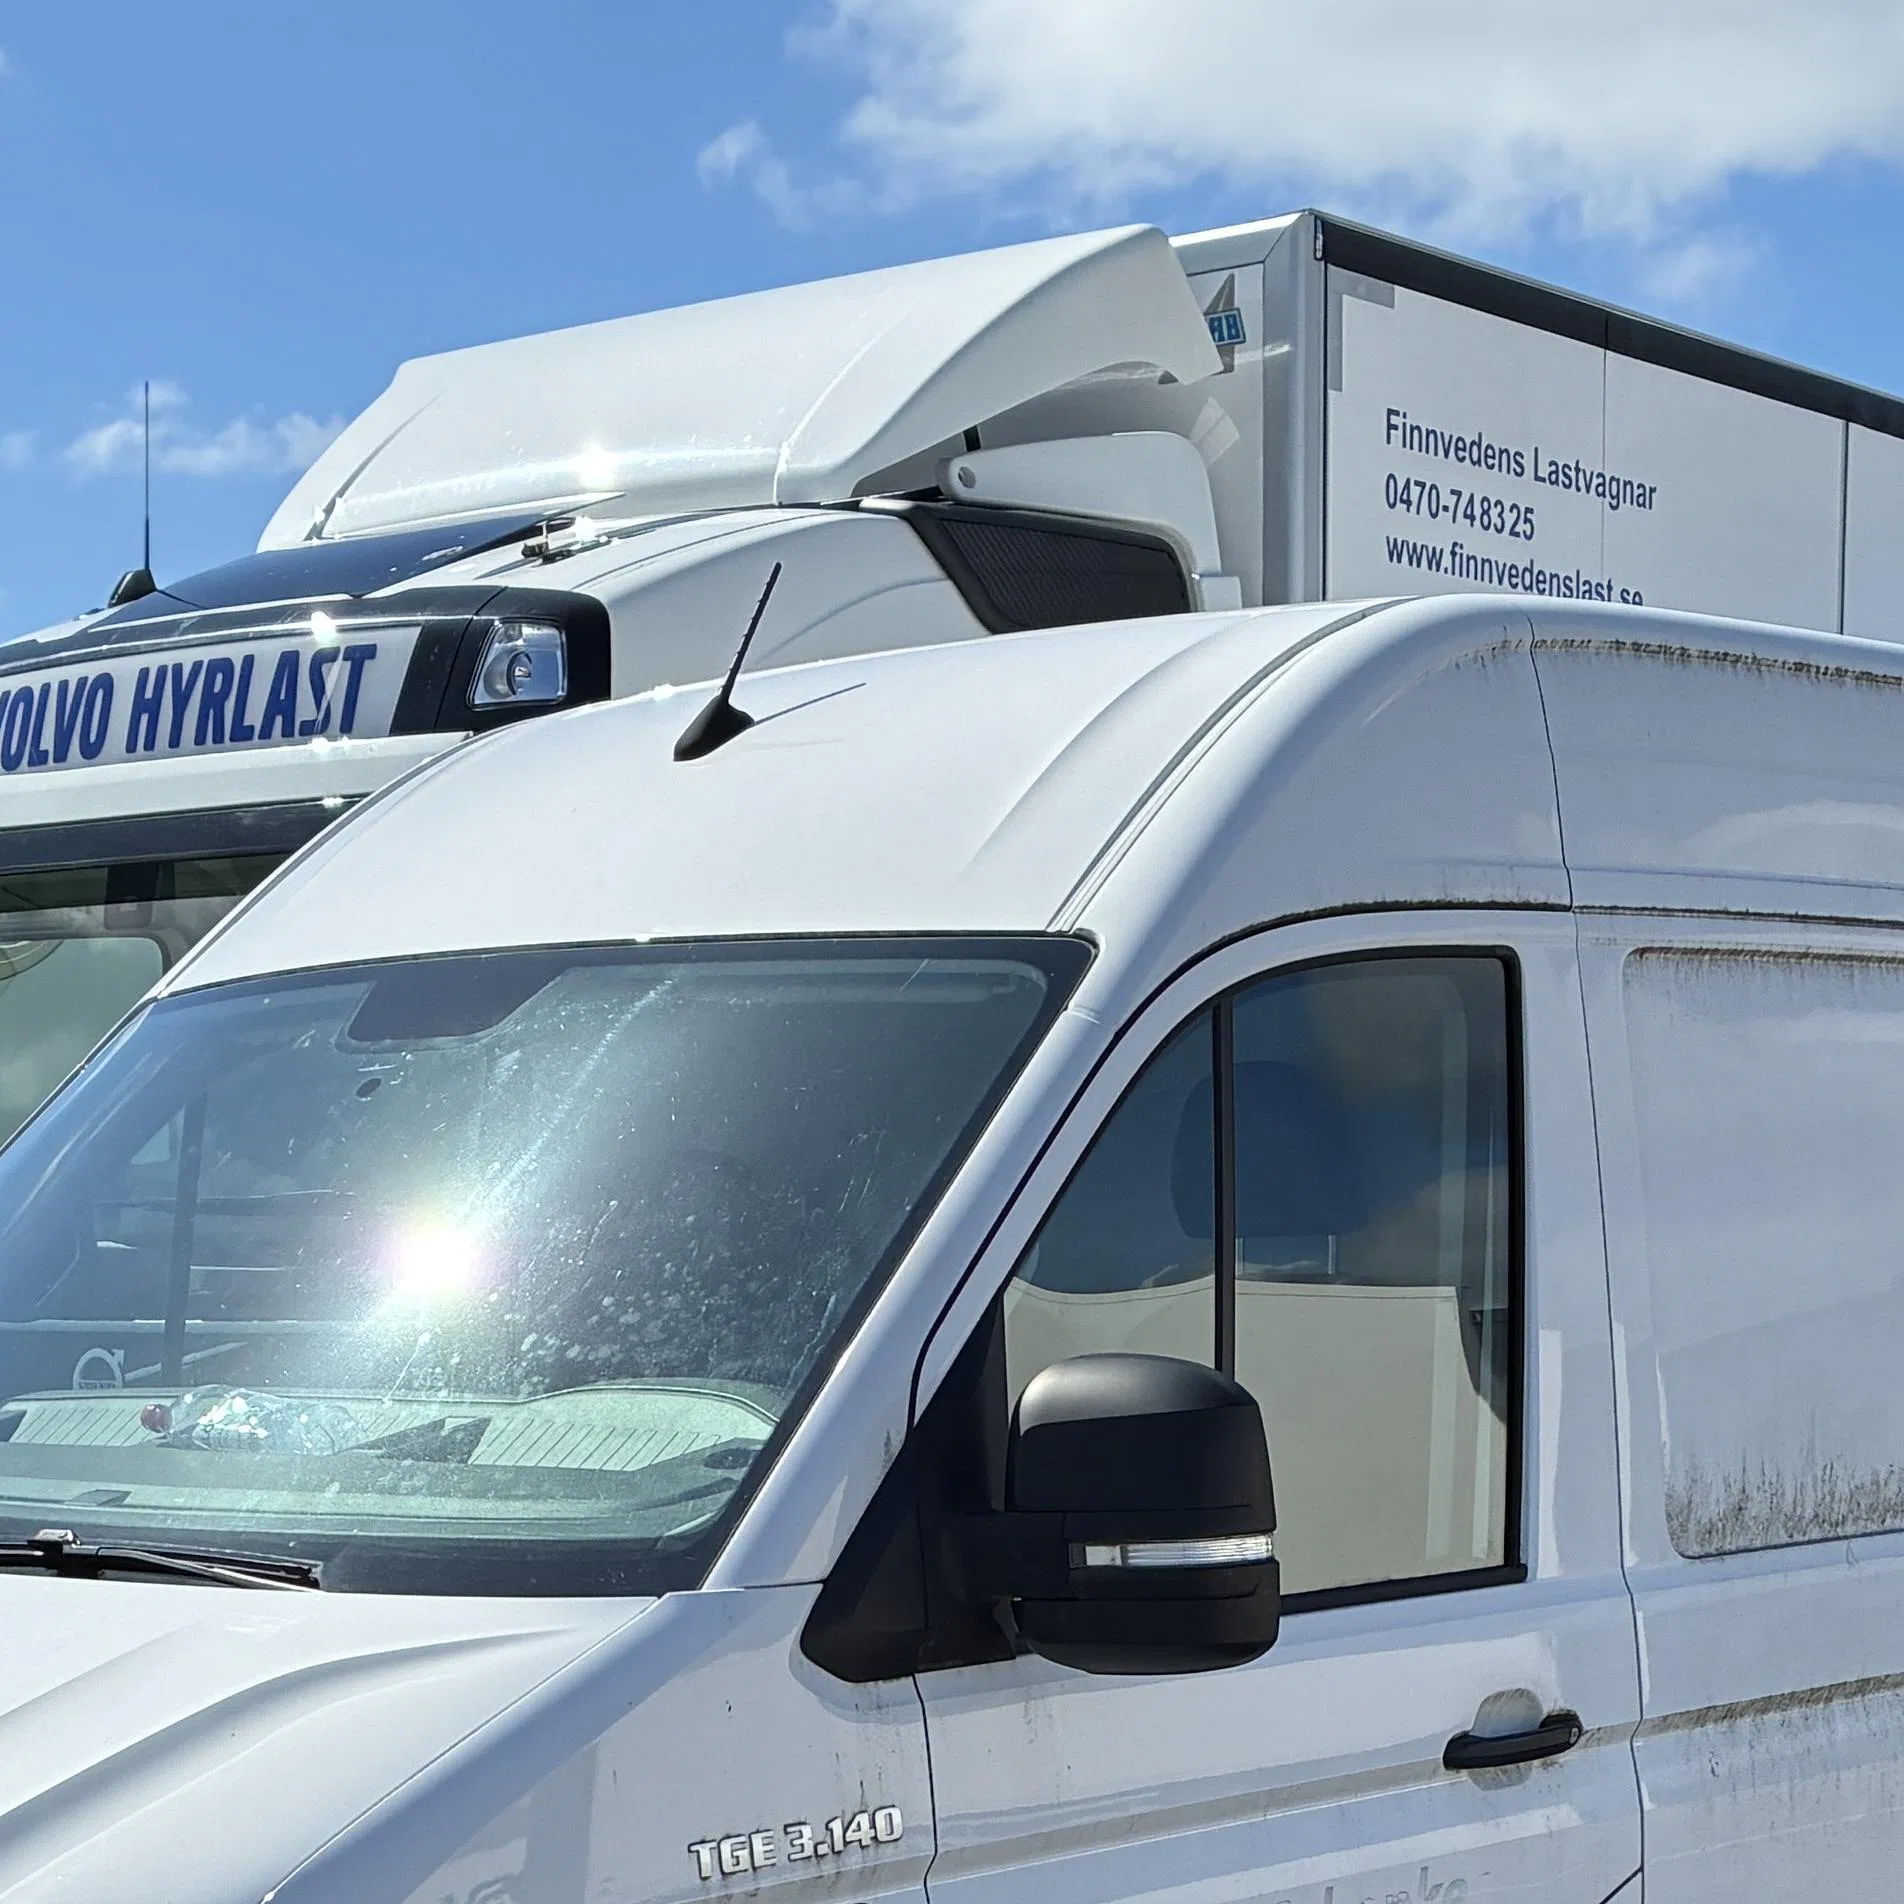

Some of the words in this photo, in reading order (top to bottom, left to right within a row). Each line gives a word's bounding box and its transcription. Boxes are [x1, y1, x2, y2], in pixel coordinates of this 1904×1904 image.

[1386, 407, 1525, 478] Finnvedens
[1533, 446, 1657, 511] Lastvagnar
[1385, 473, 1535, 541] 0470-748325
[1386, 535, 1644, 606] www.finnvedenslastse
[125, 643, 377, 754] HYRLAST
[689, 1828, 778, 1880] TGE
[784, 1804, 904, 1863] 3.140
